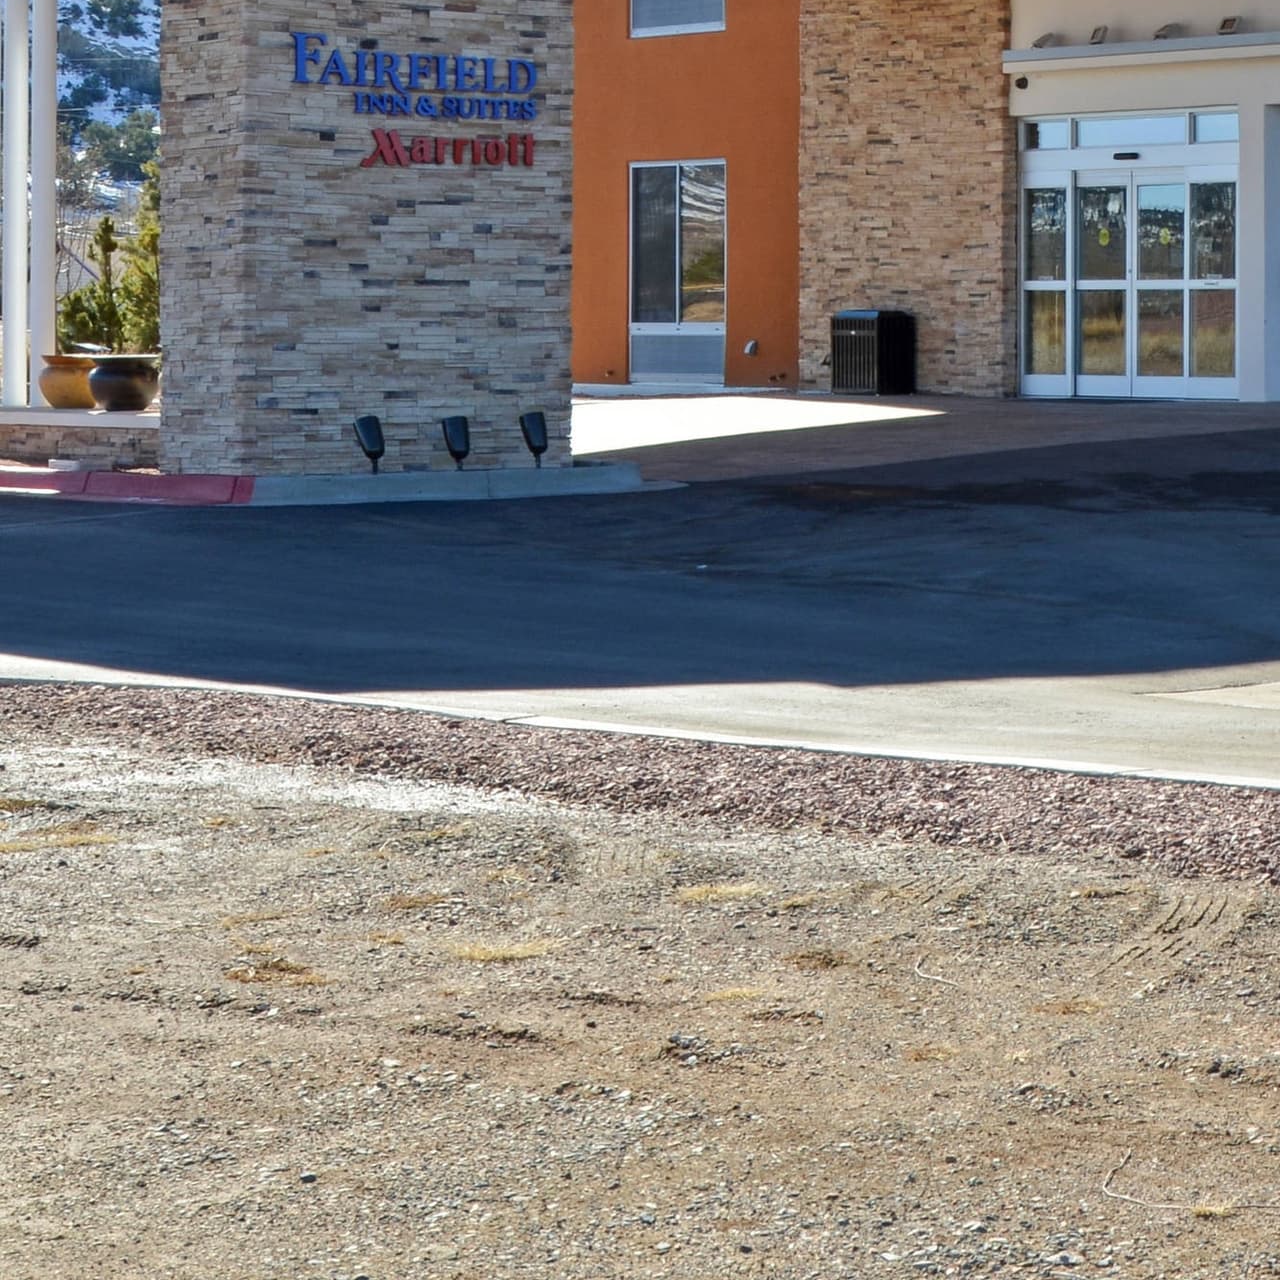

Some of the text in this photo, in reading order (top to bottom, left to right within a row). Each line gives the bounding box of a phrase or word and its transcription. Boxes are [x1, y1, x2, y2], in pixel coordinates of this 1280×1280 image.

[290, 31, 538, 94] FAIRFIELD
[354, 91, 538, 121] INN & SUITES
[359, 128, 537, 168] Marriott
